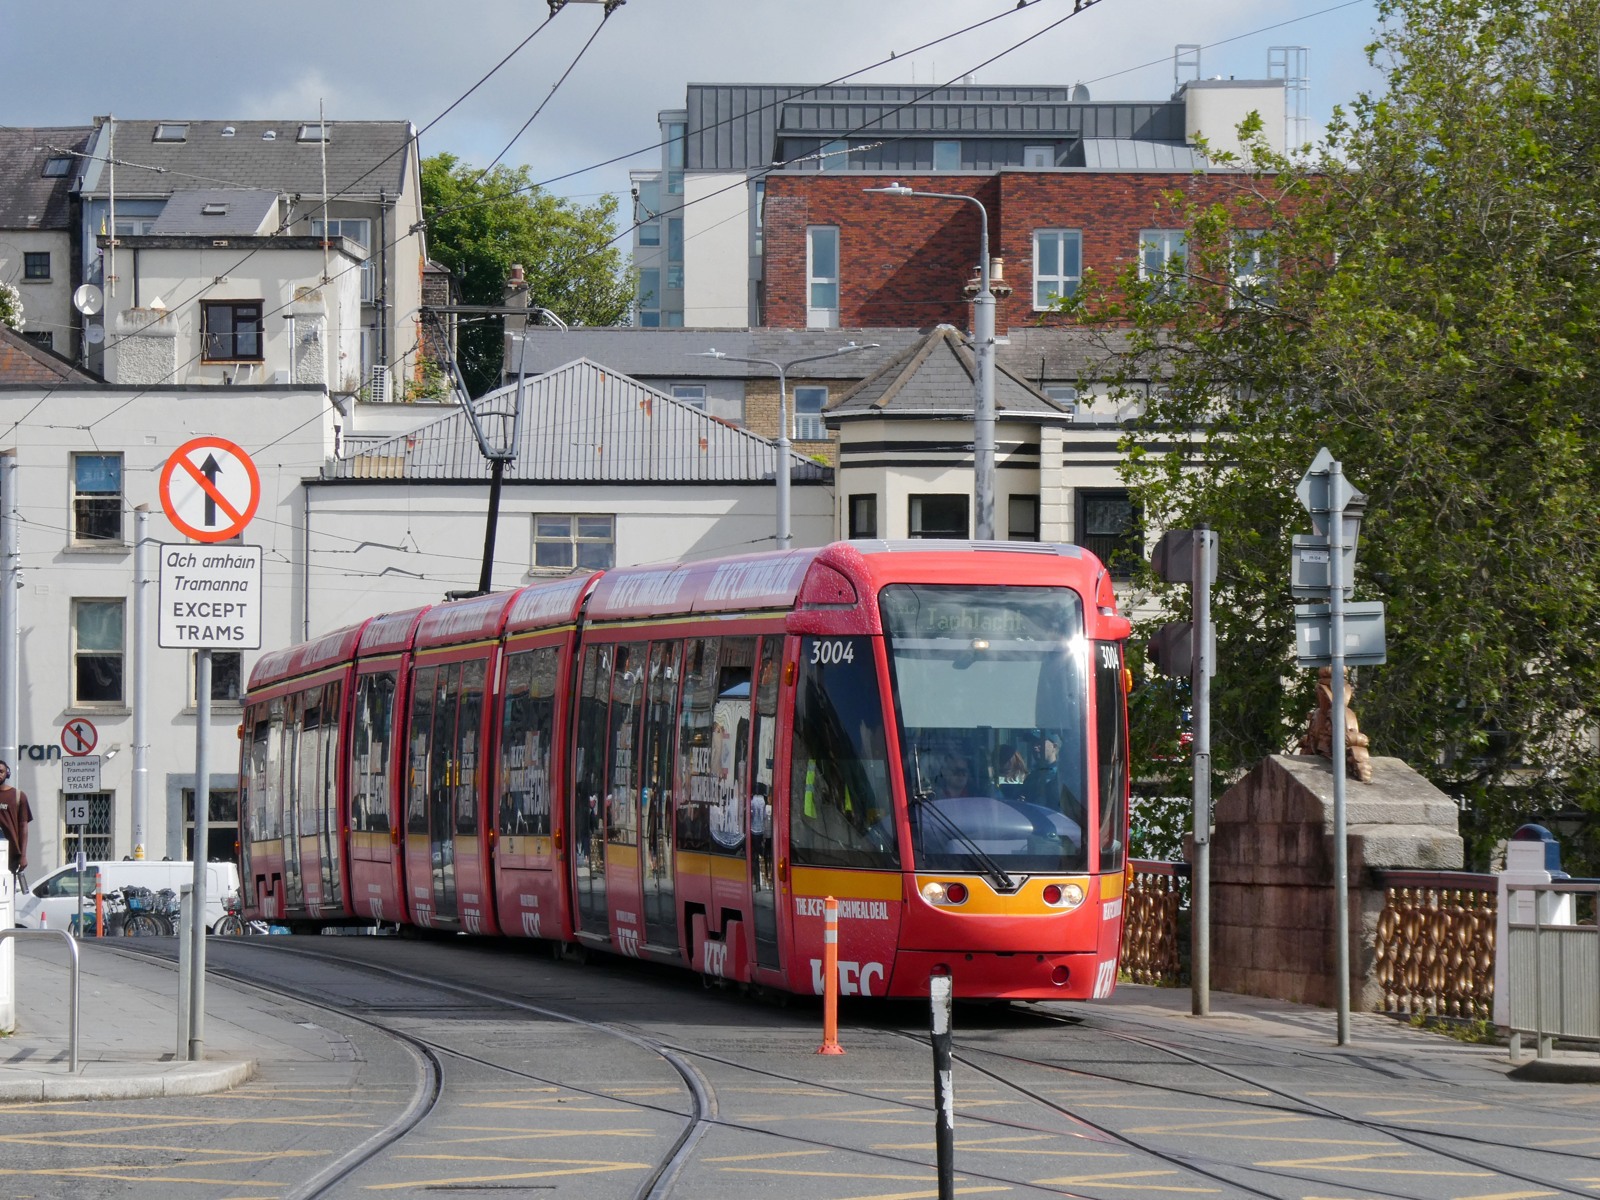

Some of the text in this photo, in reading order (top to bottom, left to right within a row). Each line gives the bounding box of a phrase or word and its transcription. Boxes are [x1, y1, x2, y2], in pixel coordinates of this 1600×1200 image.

[202, 552, 255, 569] amháin
[174, 576, 249, 592] Tramanna
[173, 602, 248, 618] EXCEPT
[176, 625, 245, 641] TRAMS
[810, 641, 854, 664] 3004
[1100, 645, 1119, 669] 3004
[70, 807, 85, 818] 15
[795, 897, 807, 915] THE
[837, 900, 851, 918] NCH
[851, 901, 870, 919] MEAL
[870, 902, 889, 920] DEAL
[704, 941, 728, 977] KFC
